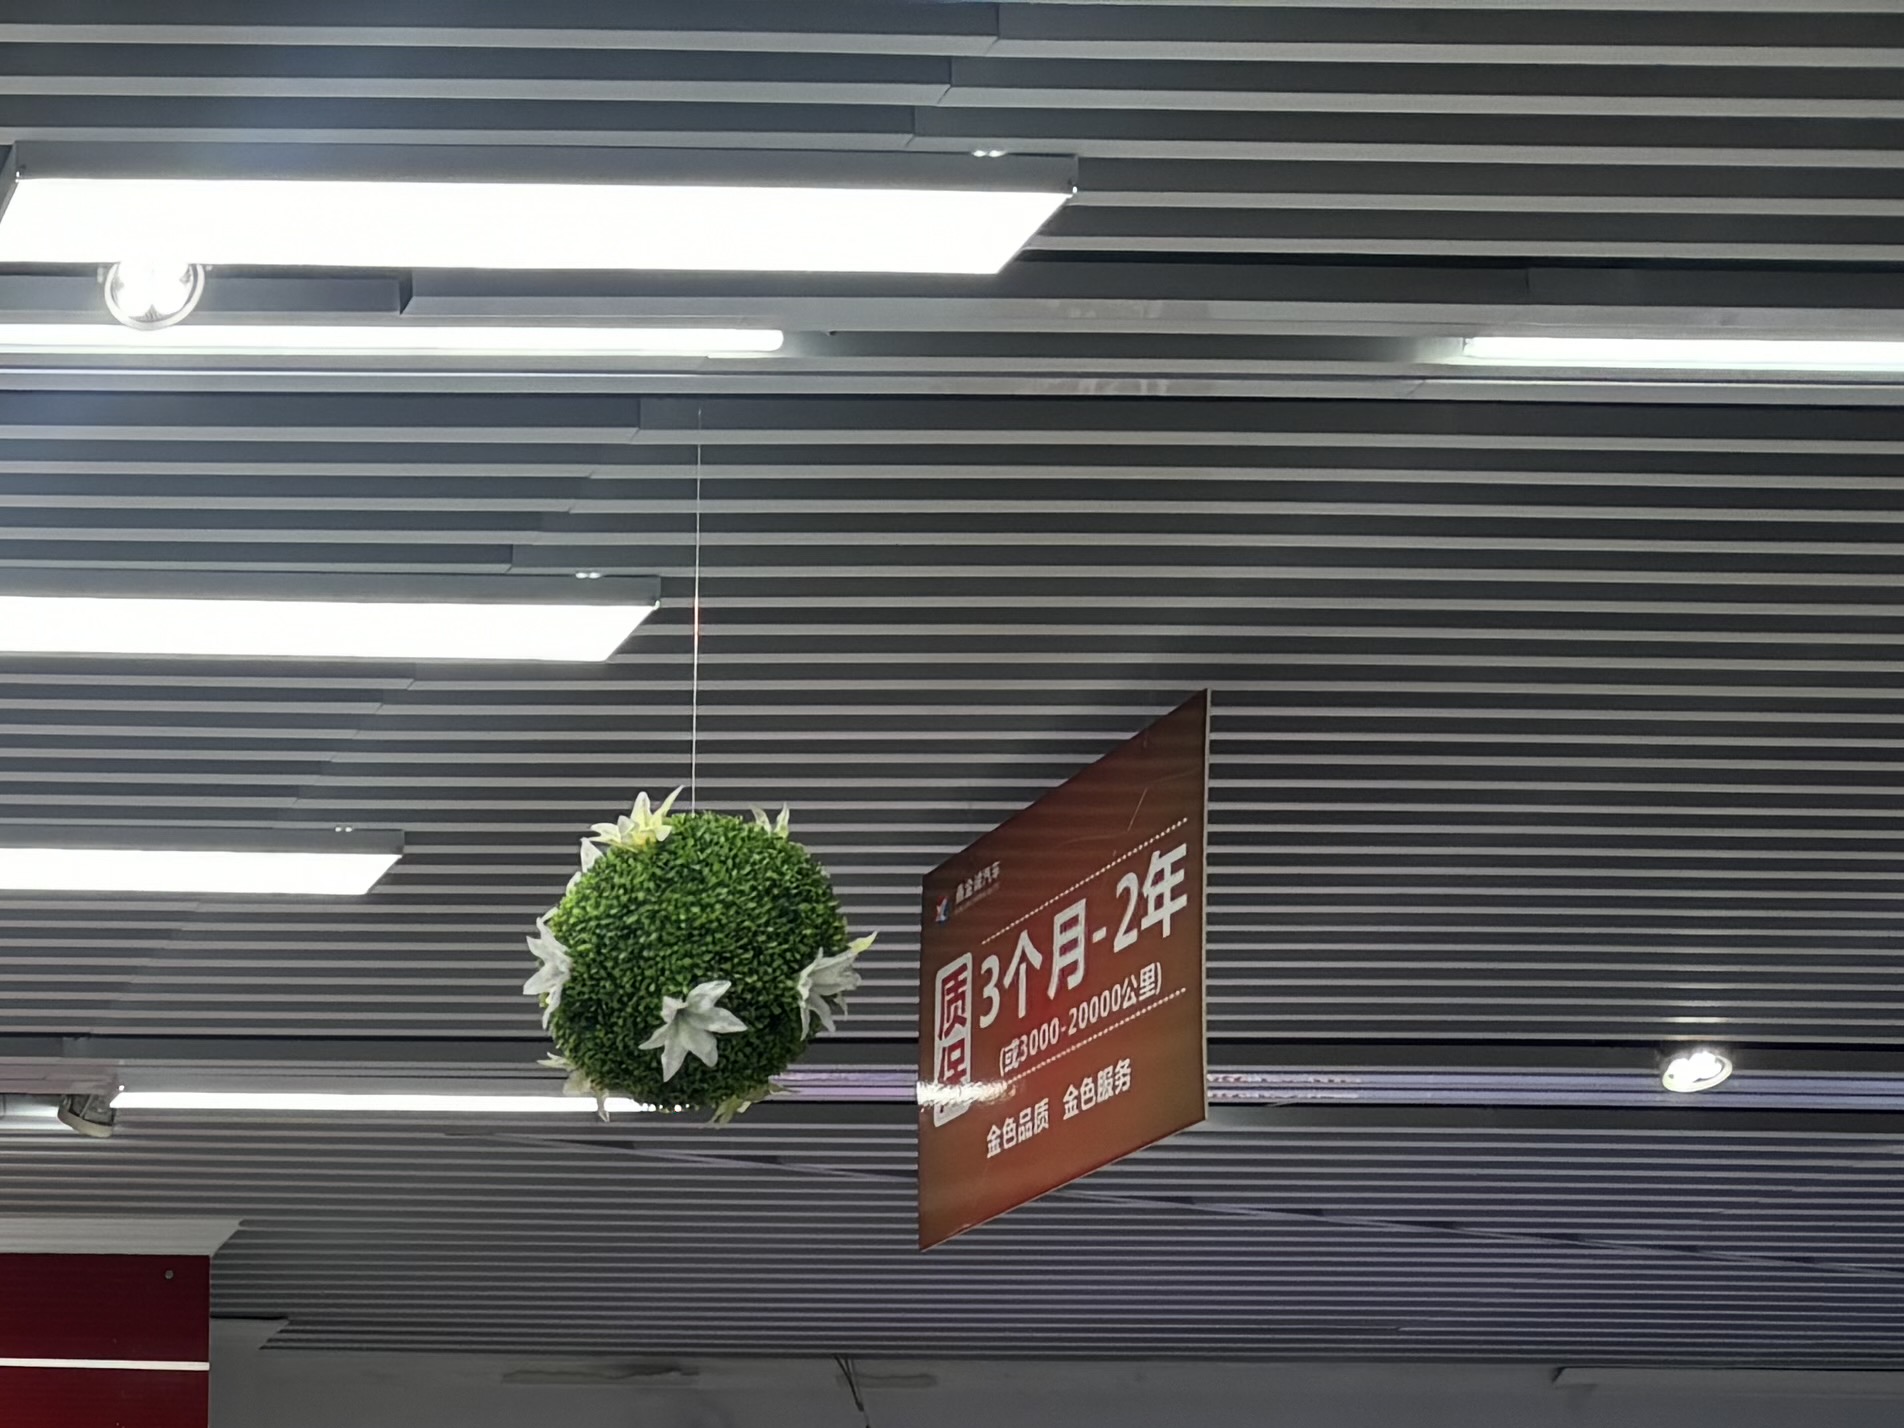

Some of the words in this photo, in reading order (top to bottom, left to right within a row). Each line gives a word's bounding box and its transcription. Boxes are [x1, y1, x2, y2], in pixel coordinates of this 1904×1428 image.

[979, 844, 1188, 1030] 3个月-2年
[987, 1098, 1049, 1158] 金色品质
[1063, 1058, 1132, 1120] 金色服务
